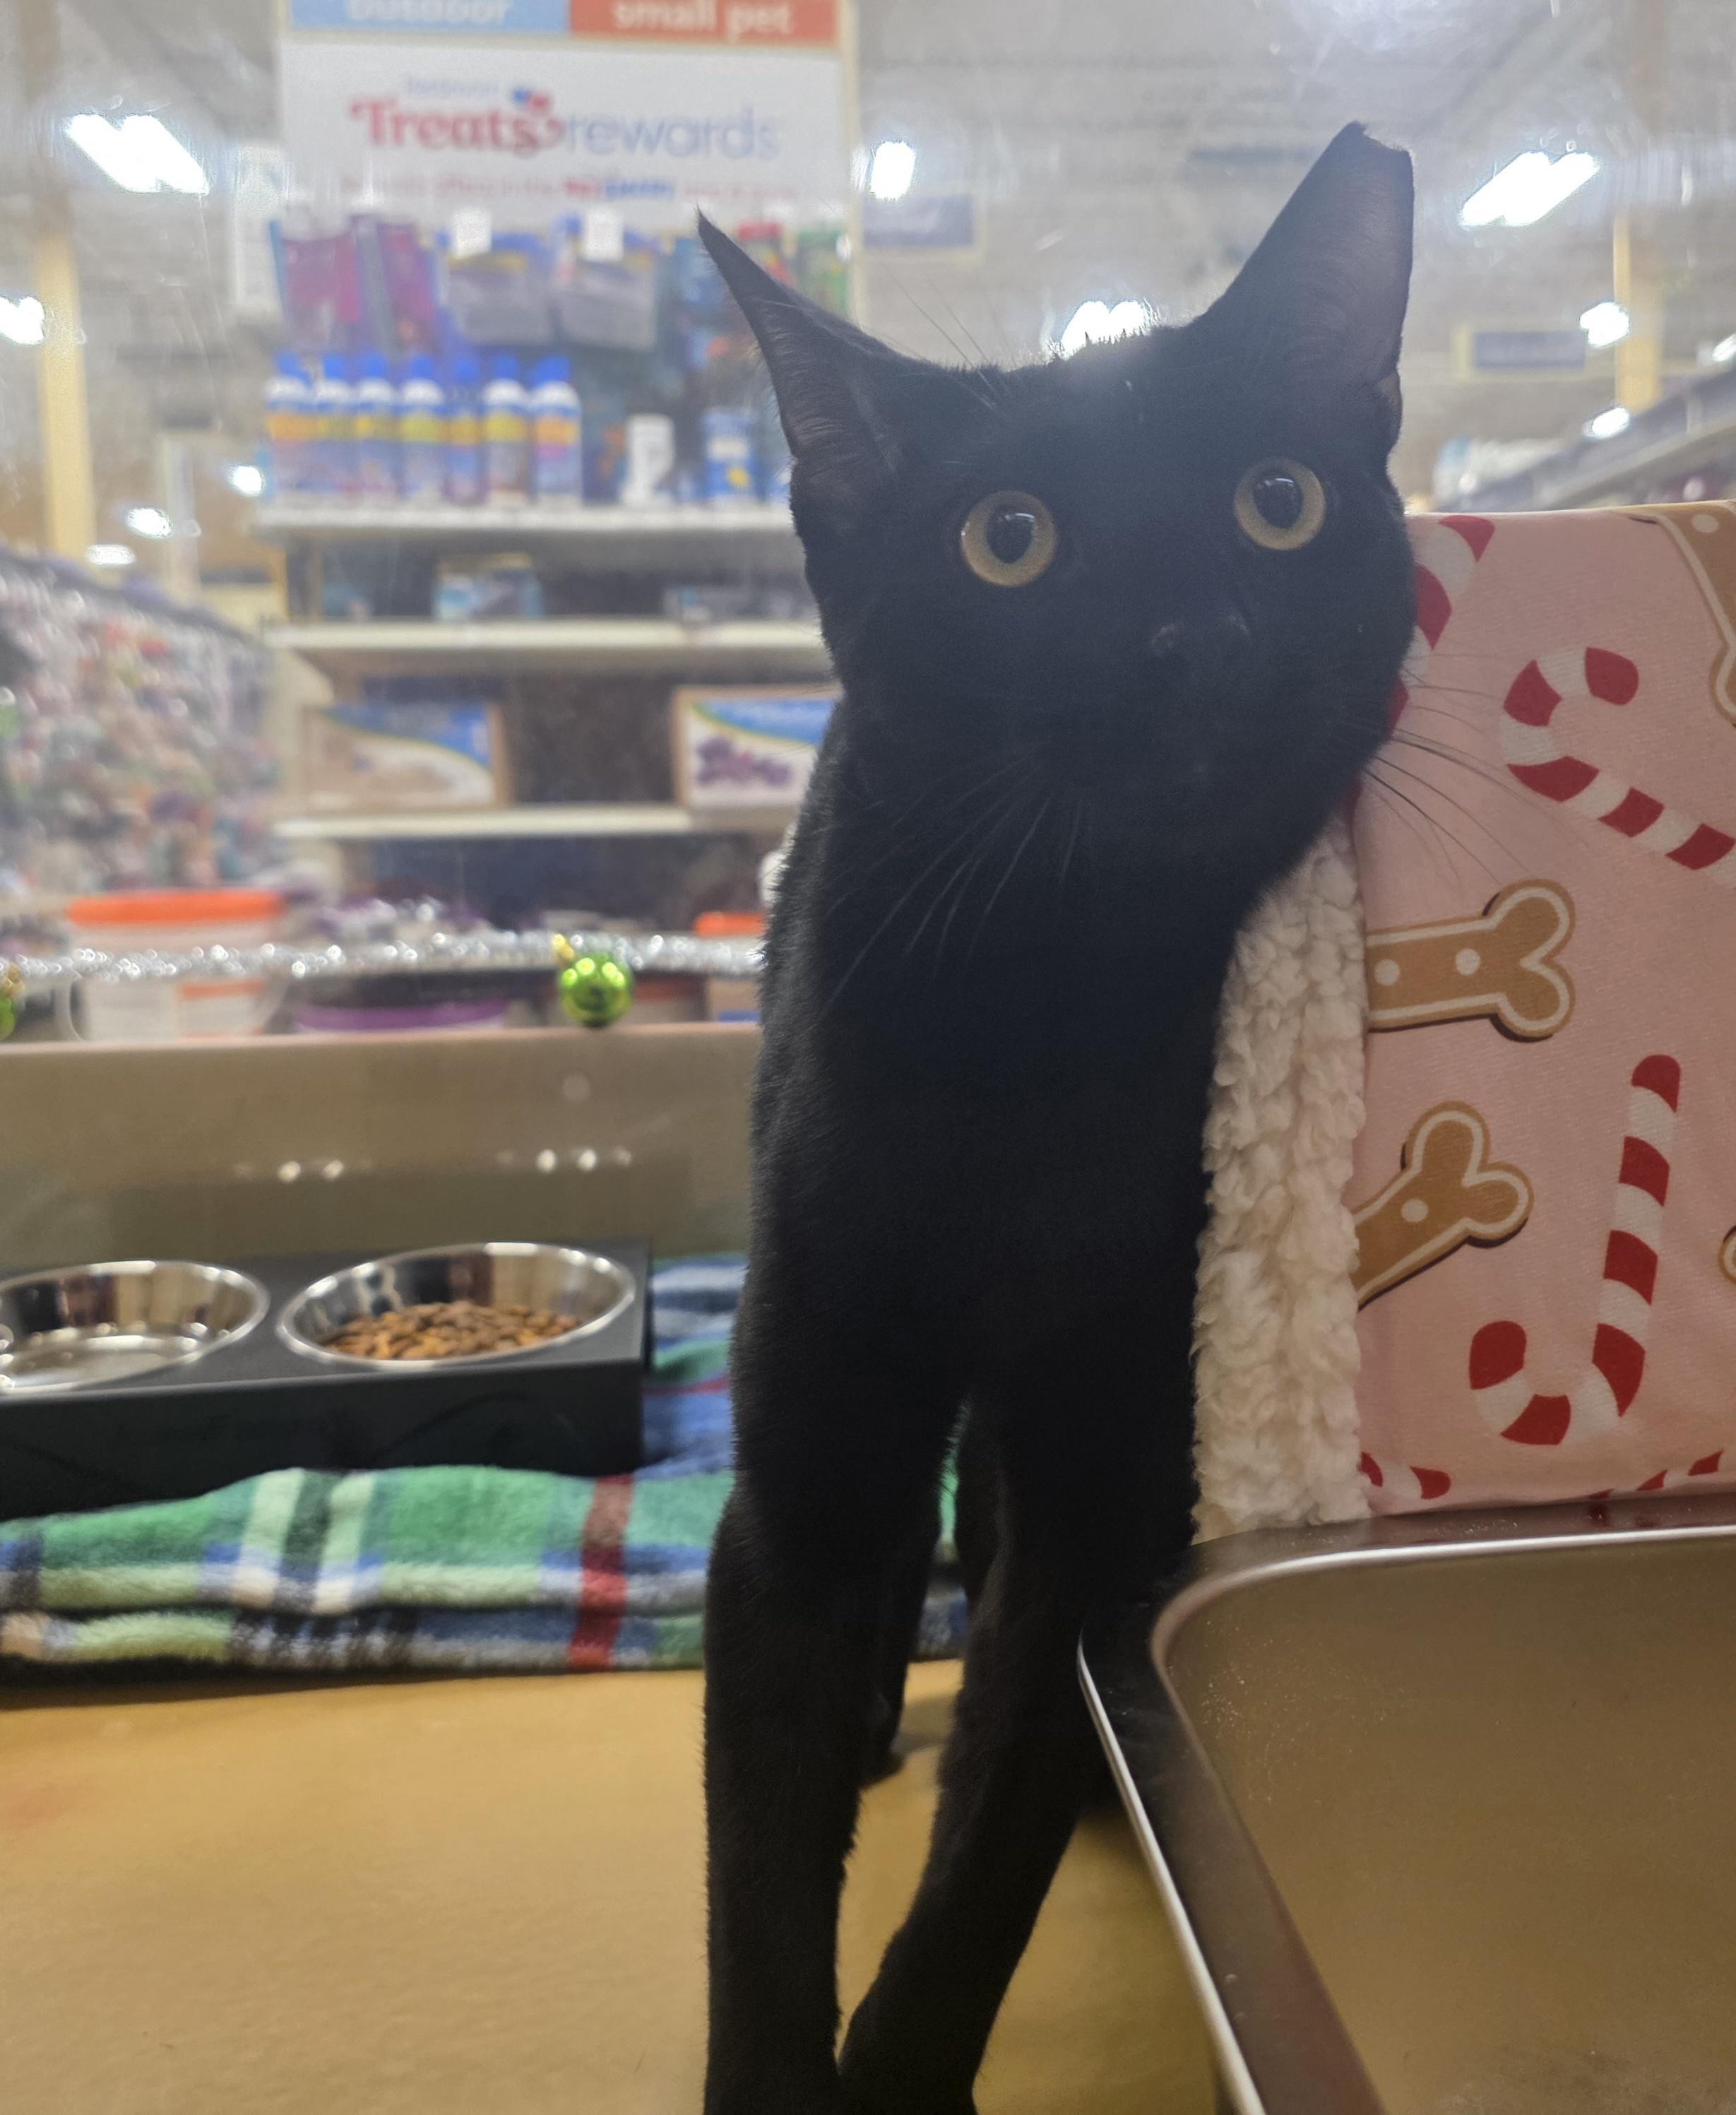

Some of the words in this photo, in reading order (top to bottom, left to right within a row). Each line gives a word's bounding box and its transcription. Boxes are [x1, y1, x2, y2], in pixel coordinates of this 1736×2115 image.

[613, 0, 716, 31] small
[725, 3, 792, 44] pet
[347, 95, 566, 157] Treats
[566, 105, 780, 160] rewards
